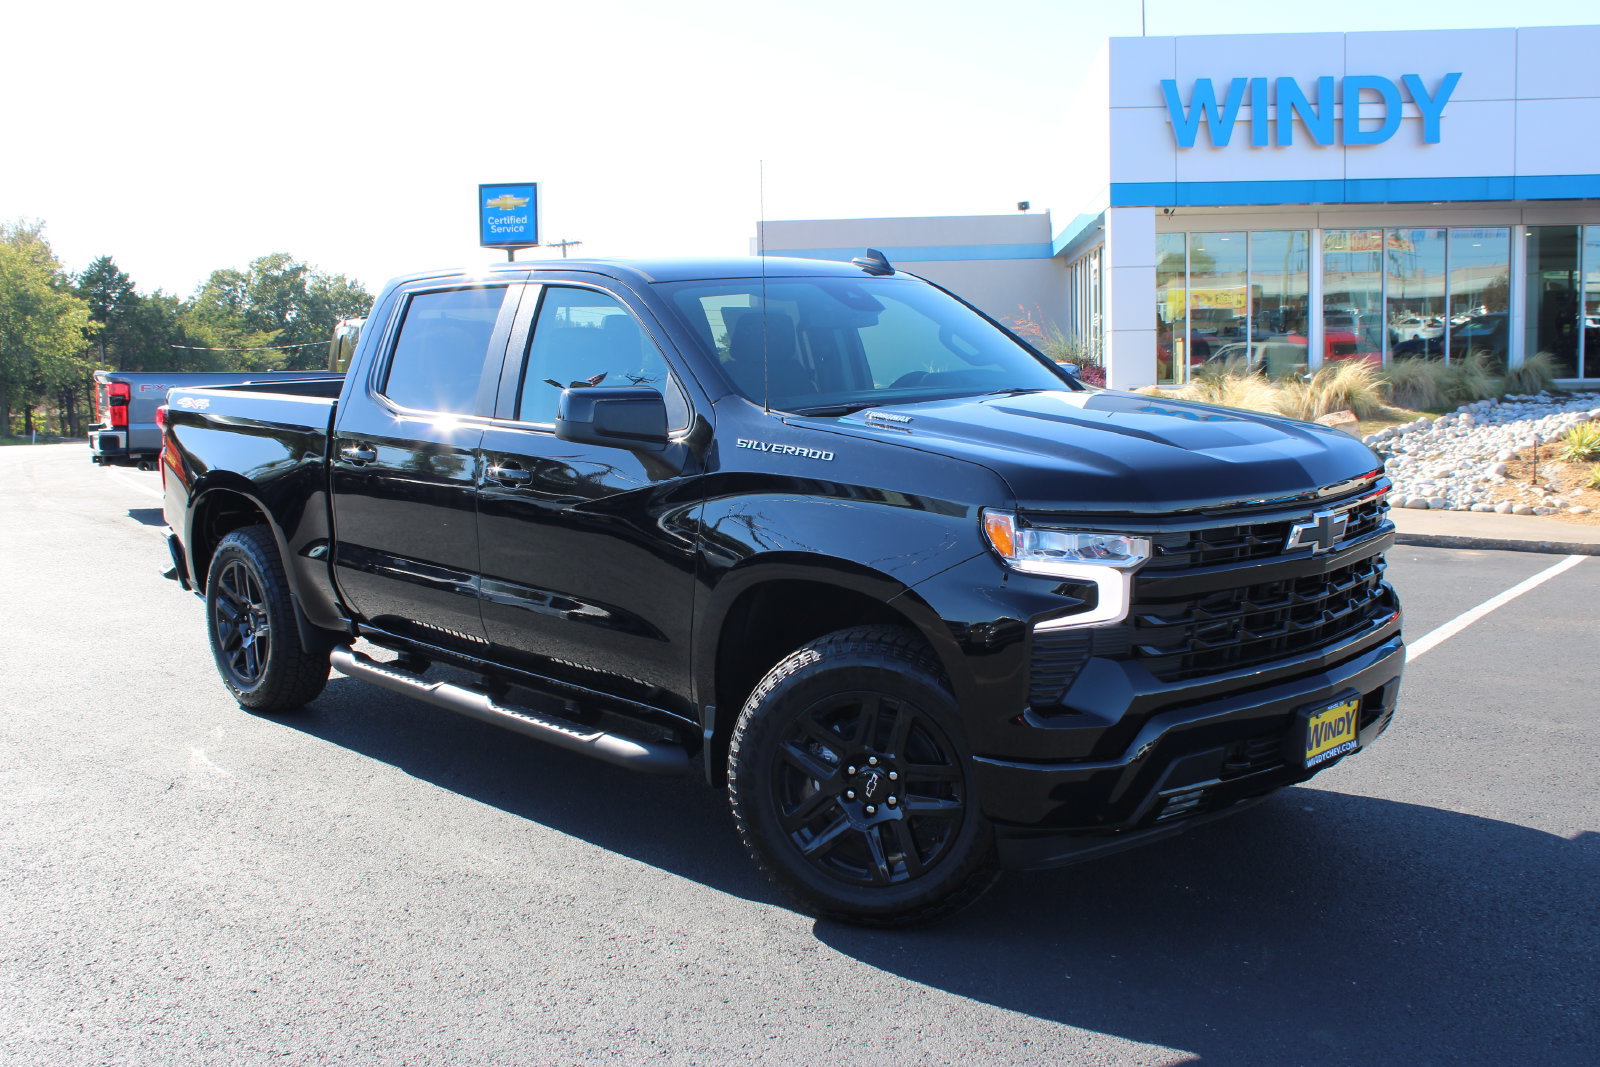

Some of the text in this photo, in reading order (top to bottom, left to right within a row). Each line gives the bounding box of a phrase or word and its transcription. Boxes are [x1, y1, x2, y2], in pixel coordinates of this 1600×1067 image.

[1160, 72, 1463, 148] WINDY
[488, 216, 527, 225] Certified
[491, 225, 524, 233] Service
[736, 438, 835, 461] SILVERADO
[1306, 708, 1356, 751] WINDY
